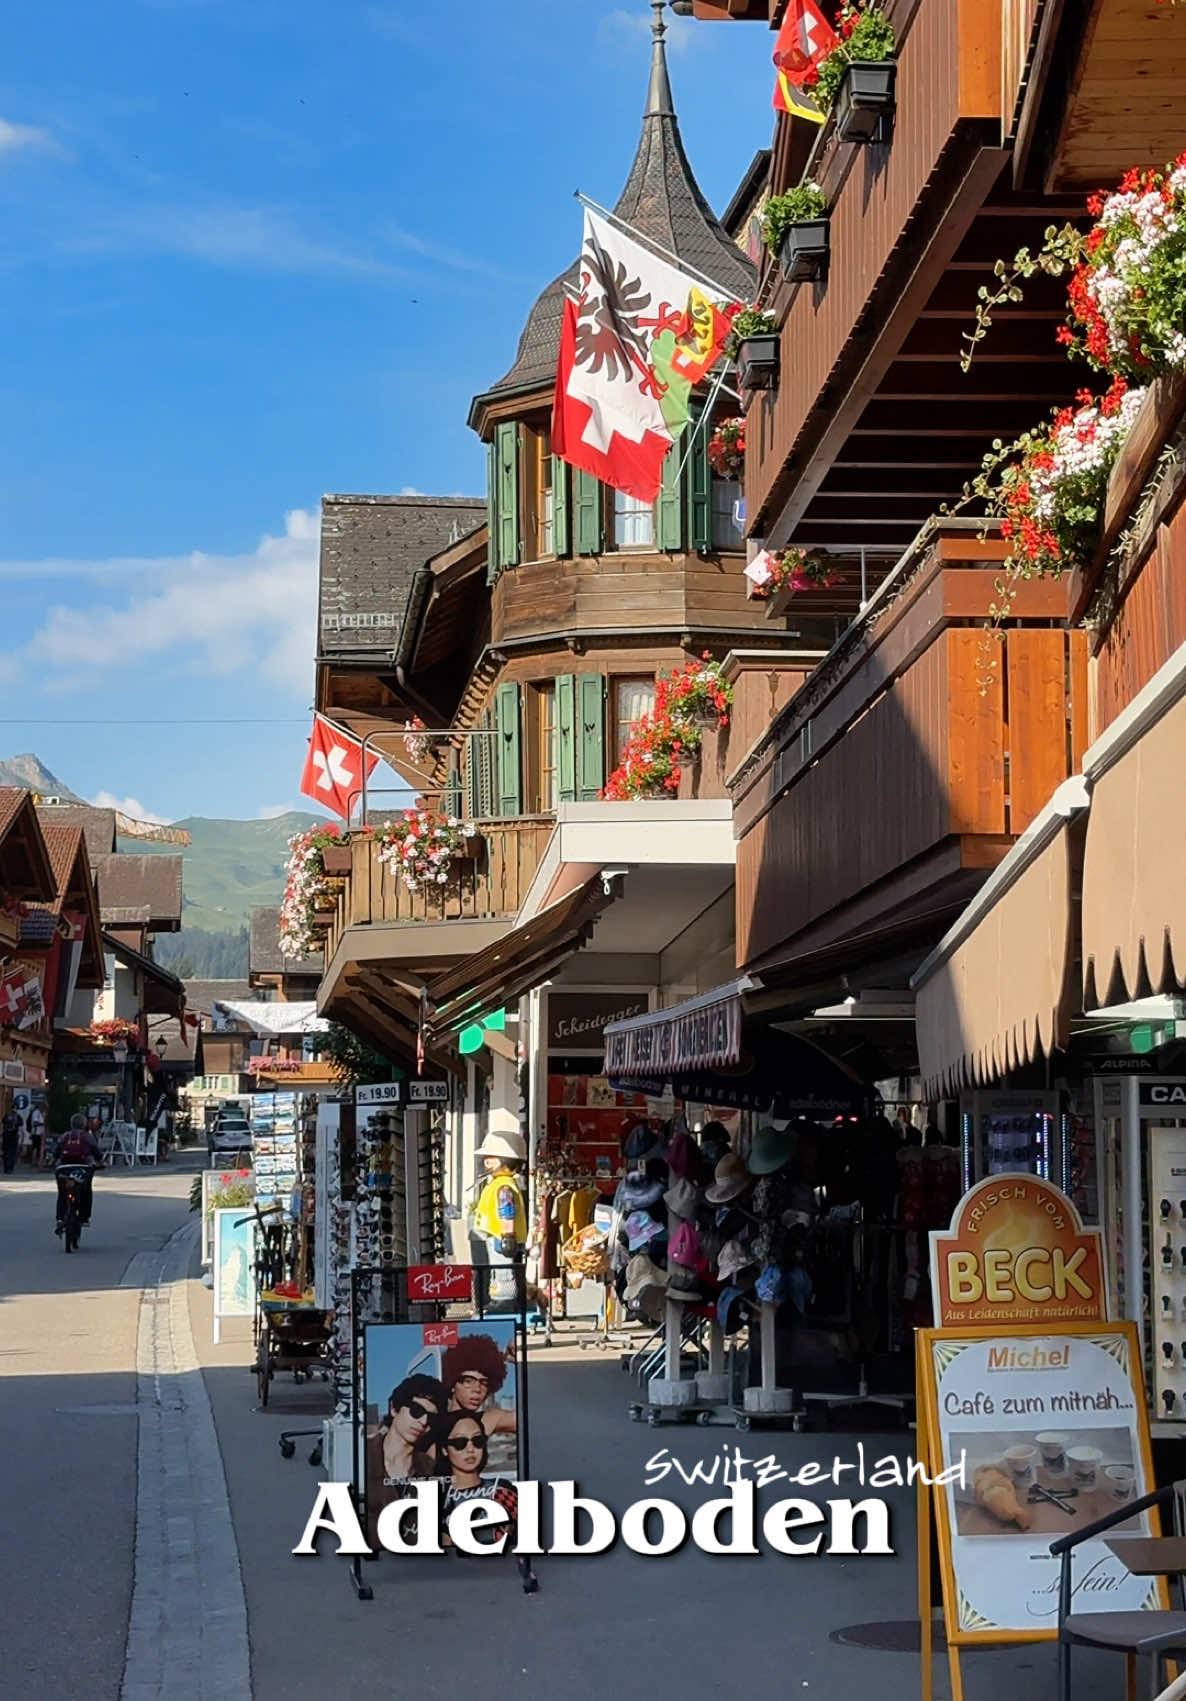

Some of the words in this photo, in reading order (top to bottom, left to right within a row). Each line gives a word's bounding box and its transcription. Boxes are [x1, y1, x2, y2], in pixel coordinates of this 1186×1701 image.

[556, 1005, 640, 1038] Scheidegger
[1100, 1060, 1152, 1069] ALPINA
[371, 1087, 396, 1098] 19.90
[424, 1084, 446, 1097] 19.90
[681, 1083, 762, 1107] MINERAL
[967, 1187, 1026, 1232] FRISCH
[1036, 1195, 1065, 1231] VOM
[414, 1266, 464, 1293] Ray-Ban
[947, 1248, 1093, 1304] BECK
[945, 1310, 966, 1321] Aus
[968, 1308, 1041, 1321] Leidenschaft
[1042, 1306, 1100, 1318] natürlich!
[988, 1345, 1070, 1368] Michel
[944, 1392, 995, 1417] Café
[1002, 1399, 1045, 1414] zum
[1051, 1388, 1134, 1411] mitnäh...
